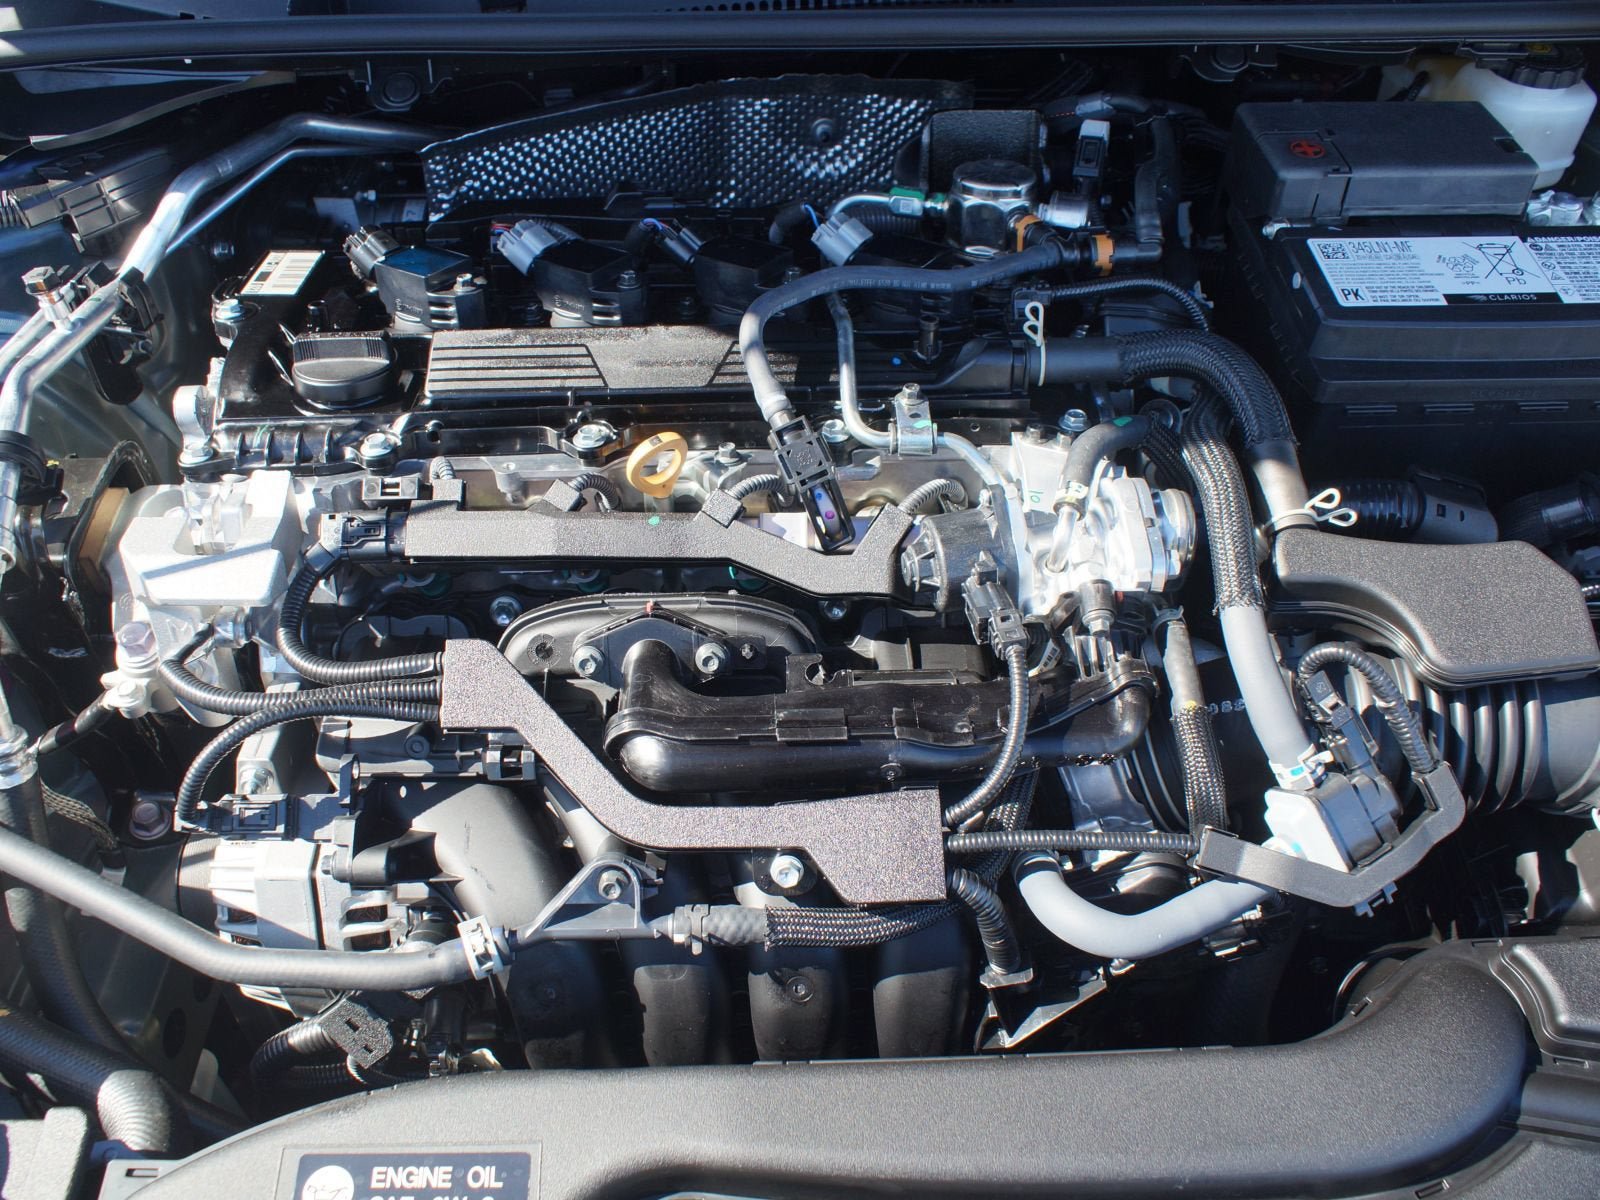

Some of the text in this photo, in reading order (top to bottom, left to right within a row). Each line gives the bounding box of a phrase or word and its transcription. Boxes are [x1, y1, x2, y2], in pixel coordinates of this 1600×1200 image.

[1348, 240, 1413, 253] 345LN1-MF
[1505, 276, 1527, 285] Pb
[1340, 288, 1365, 301] PK
[370, 1165, 503, 1189] ENGINE OIL
